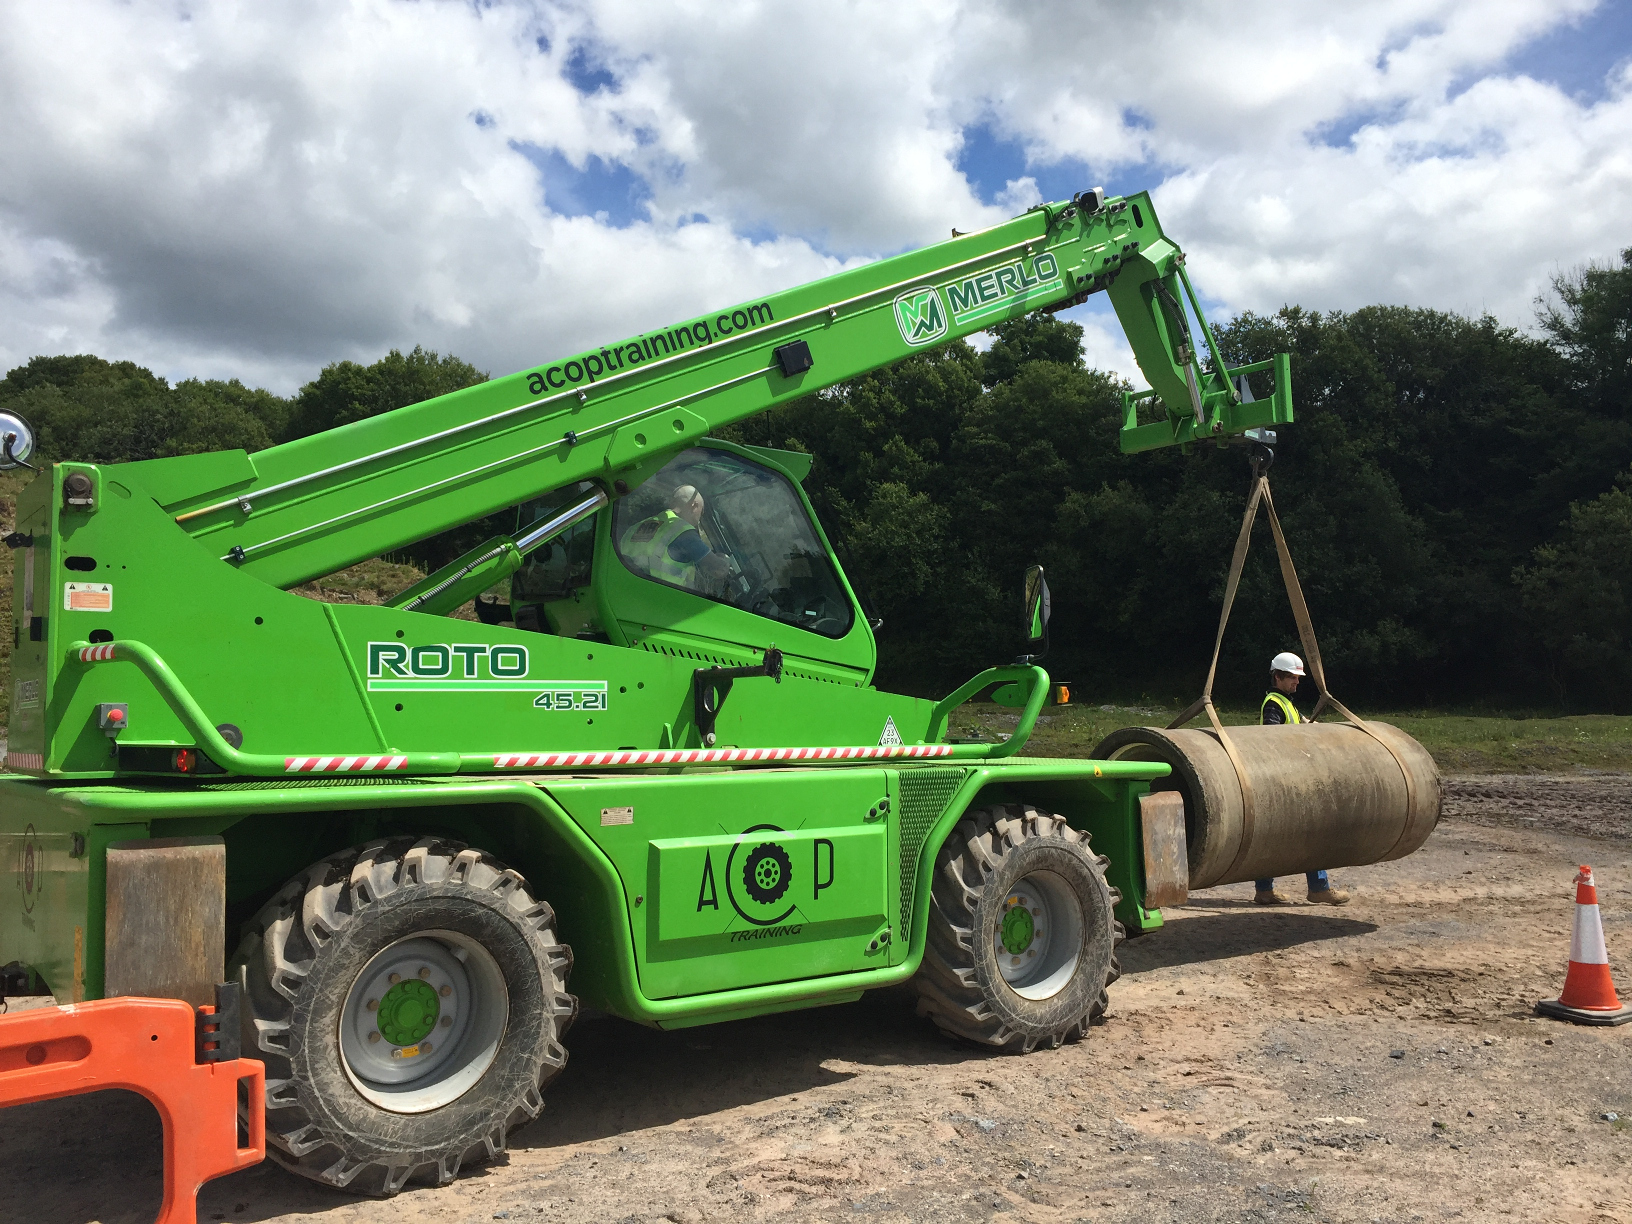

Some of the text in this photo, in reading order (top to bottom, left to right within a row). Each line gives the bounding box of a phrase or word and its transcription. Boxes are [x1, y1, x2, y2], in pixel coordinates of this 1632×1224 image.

[946, 252, 1059, 314] MERLO
[526, 302, 774, 395] acoptraining.com
[367, 641, 529, 679] ROTO
[533, 692, 608, 710] 45.21
[886, 729, 895, 737] 23
[730, 924, 803, 943] TRAINING
